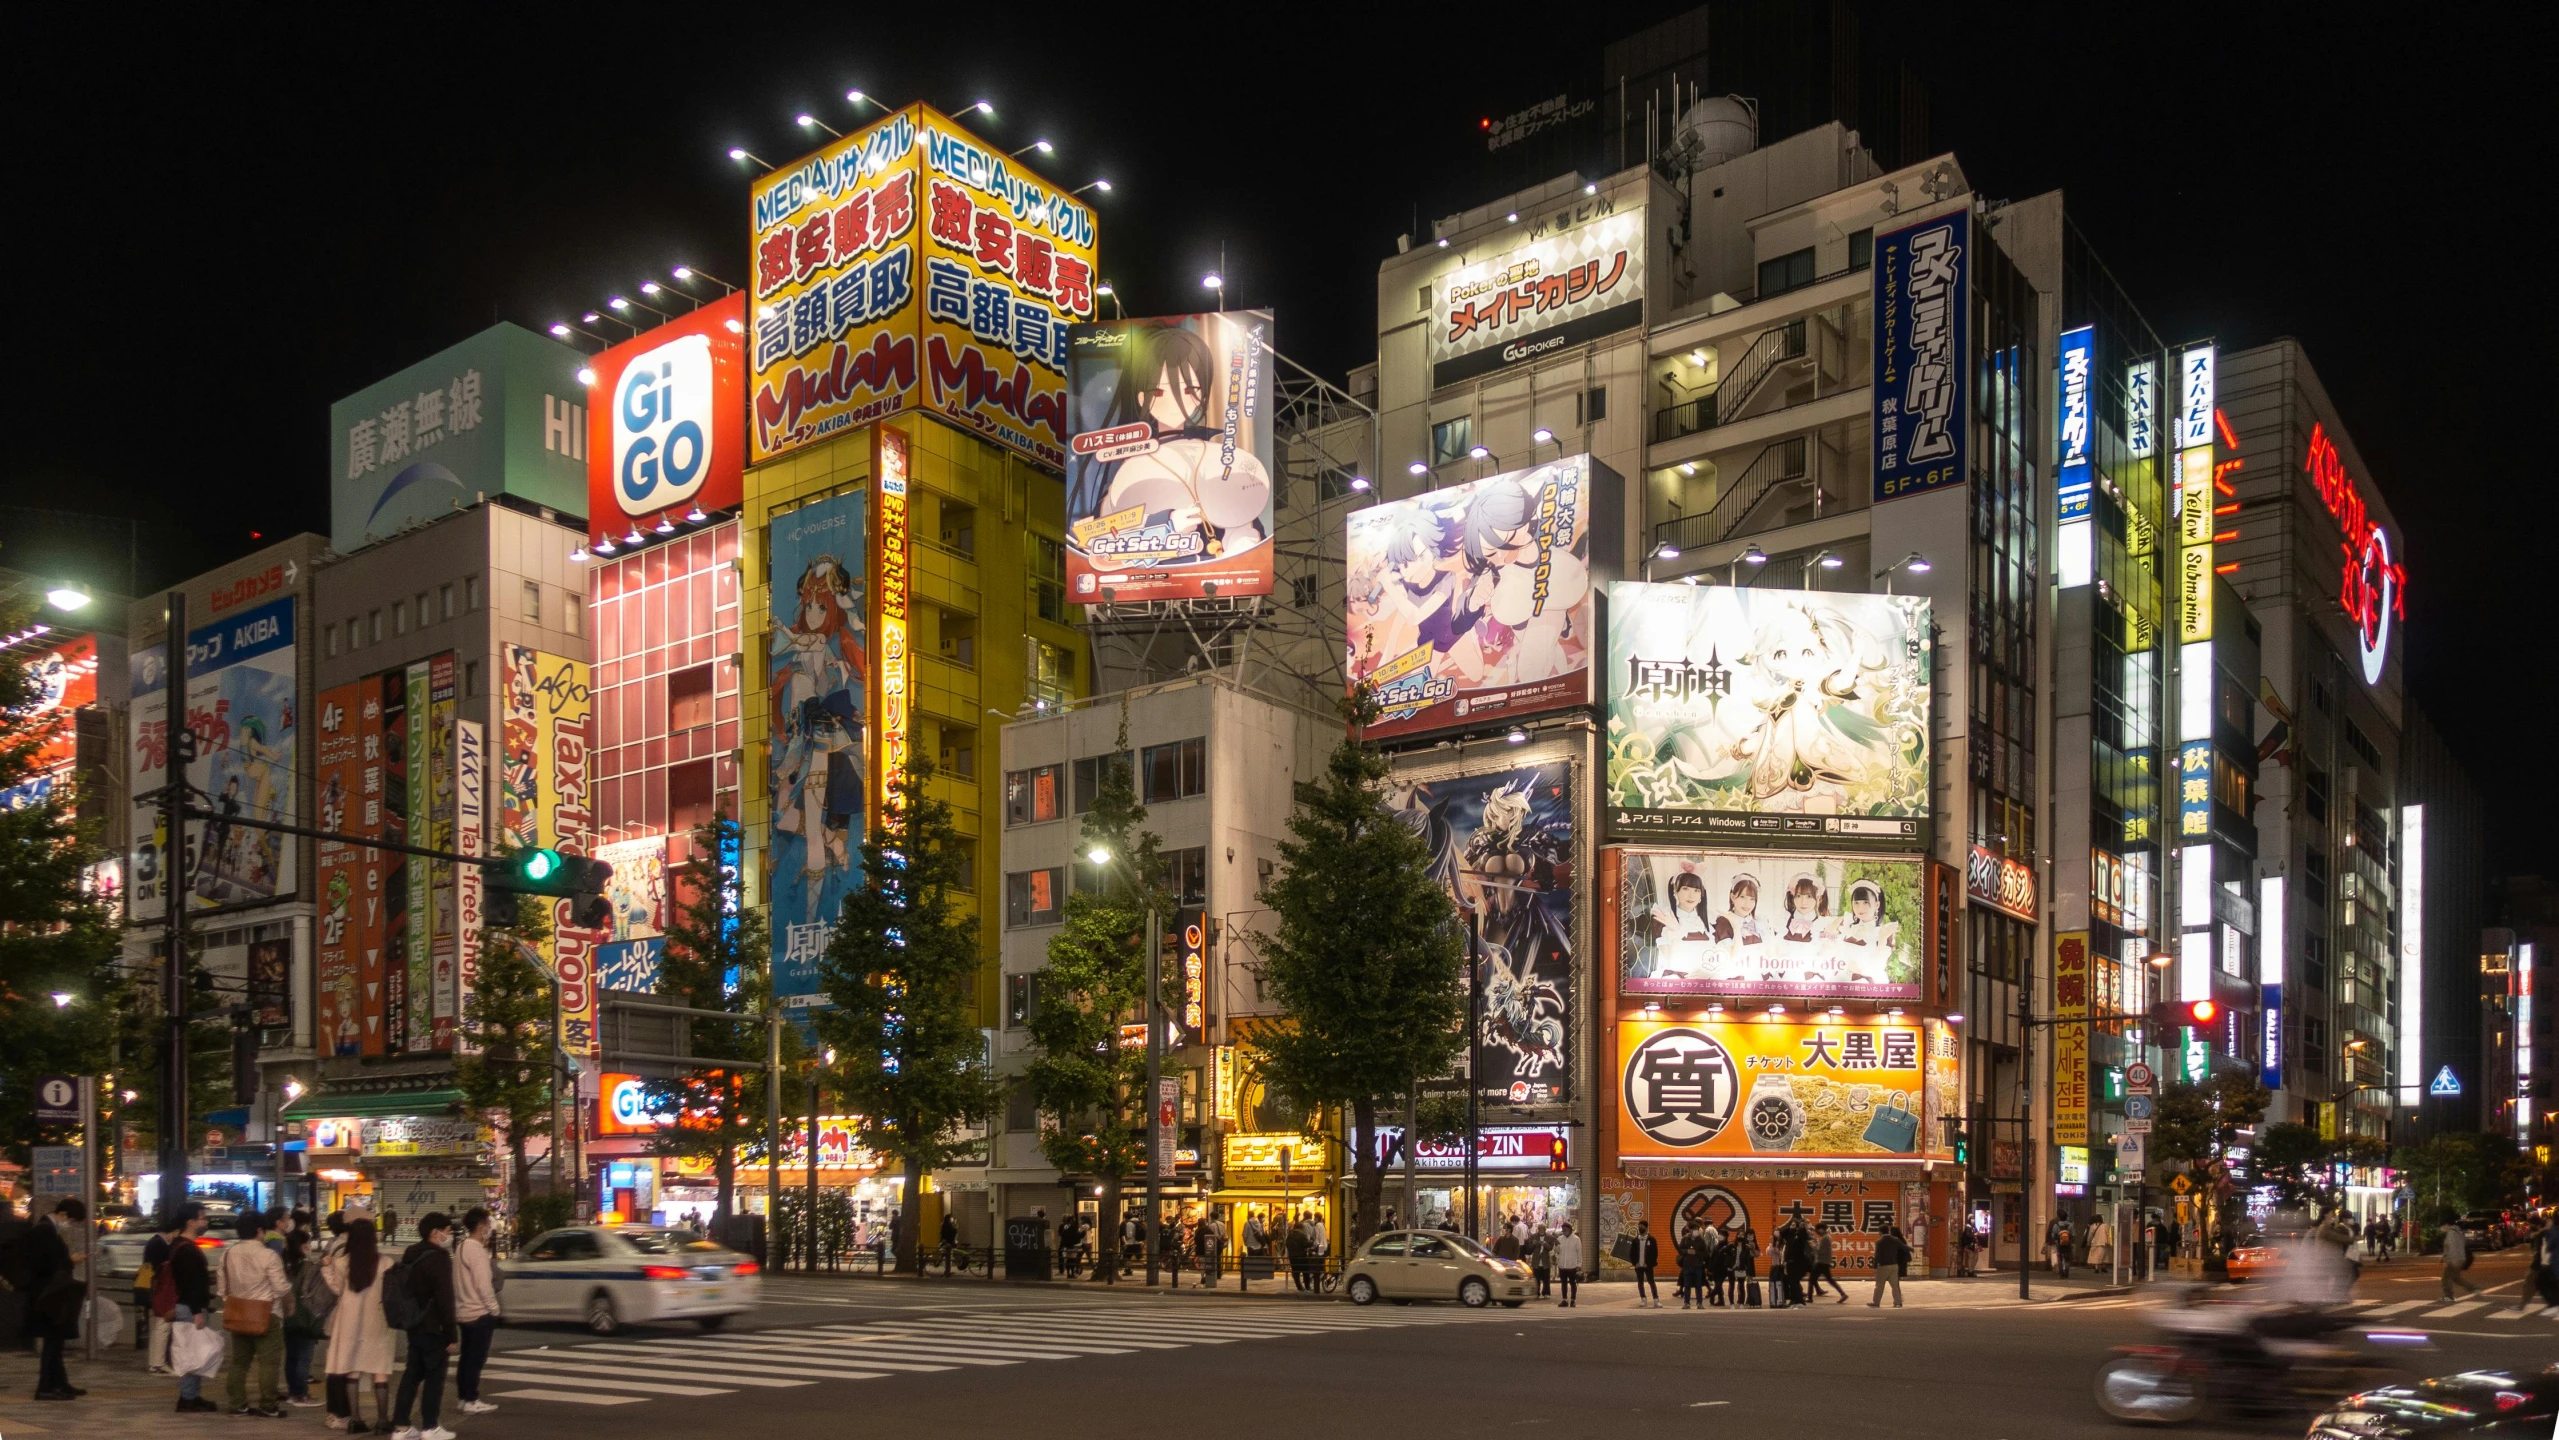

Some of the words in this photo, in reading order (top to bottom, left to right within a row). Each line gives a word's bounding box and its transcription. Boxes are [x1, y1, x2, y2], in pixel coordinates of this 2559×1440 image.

[756, 169, 914, 300] 激安販売
[927, 177, 1093, 319] 激安販売
[754, 242, 913, 375] 高額買取
[1449, 250, 1629, 343] メイドカジノ
[621, 360, 673, 434] Gi
[754, 329, 919, 453] Mulan
[2189, 356, 2209, 438] スーパービル
[545, 392, 589, 465] HI
[1881, 398, 1898, 471] 秋葉原店
[620, 419, 705, 502] GO
[883, 479, 905, 493] あなたの
[883, 495, 905, 512] DVD
[883, 523, 905, 540] ゲーム
[2185, 488, 2202, 540] Yellow
[886, 536, 902, 551] CD
[1165, 532, 1200, 551] Go!
[210, 563, 283, 614] ビックカメラ
[883, 563, 905, 579] アニメ
[2185, 551, 2203, 636] Submarine
[233, 615, 280, 650] AKIBA
[1422, 676, 1454, 699] Go!
[1623, 640, 1733, 727] 原神
[322, 701, 344, 733] 4F
[461, 725, 479, 803] AKKY
[2182, 746, 2209, 835] 秋葉館
[322, 803, 344, 834] 3F
[1708, 816, 1746, 828] Windows
[461, 823, 481, 924] Tax-free
[1967, 848, 2037, 914] メイドカジノ
[323, 914, 345, 946] 2F
[2057, 937, 2086, 1008] 免税
[1746, 1055, 1796, 1071] チケット
[1802, 1031, 1918, 1071] 大黒屋
[2072, 1012, 2086, 1051] TAX
[1486, 1088, 1508, 1097] more
[1636, 1045, 1731, 1135] 質
[2072, 1057, 2086, 1109] FREE
[2130, 1068, 2147, 1081] 40
[2056, 1122, 2086, 1130] AKIHABARA
[2130, 1101, 2141, 1117] P
[1491, 1135, 1523, 1156] ZIN
[1672, 1166, 1688, 1177] 時計
[1806, 1180, 1871, 1197] チケット
[1777, 1199, 1897, 1236] 大黒屋
